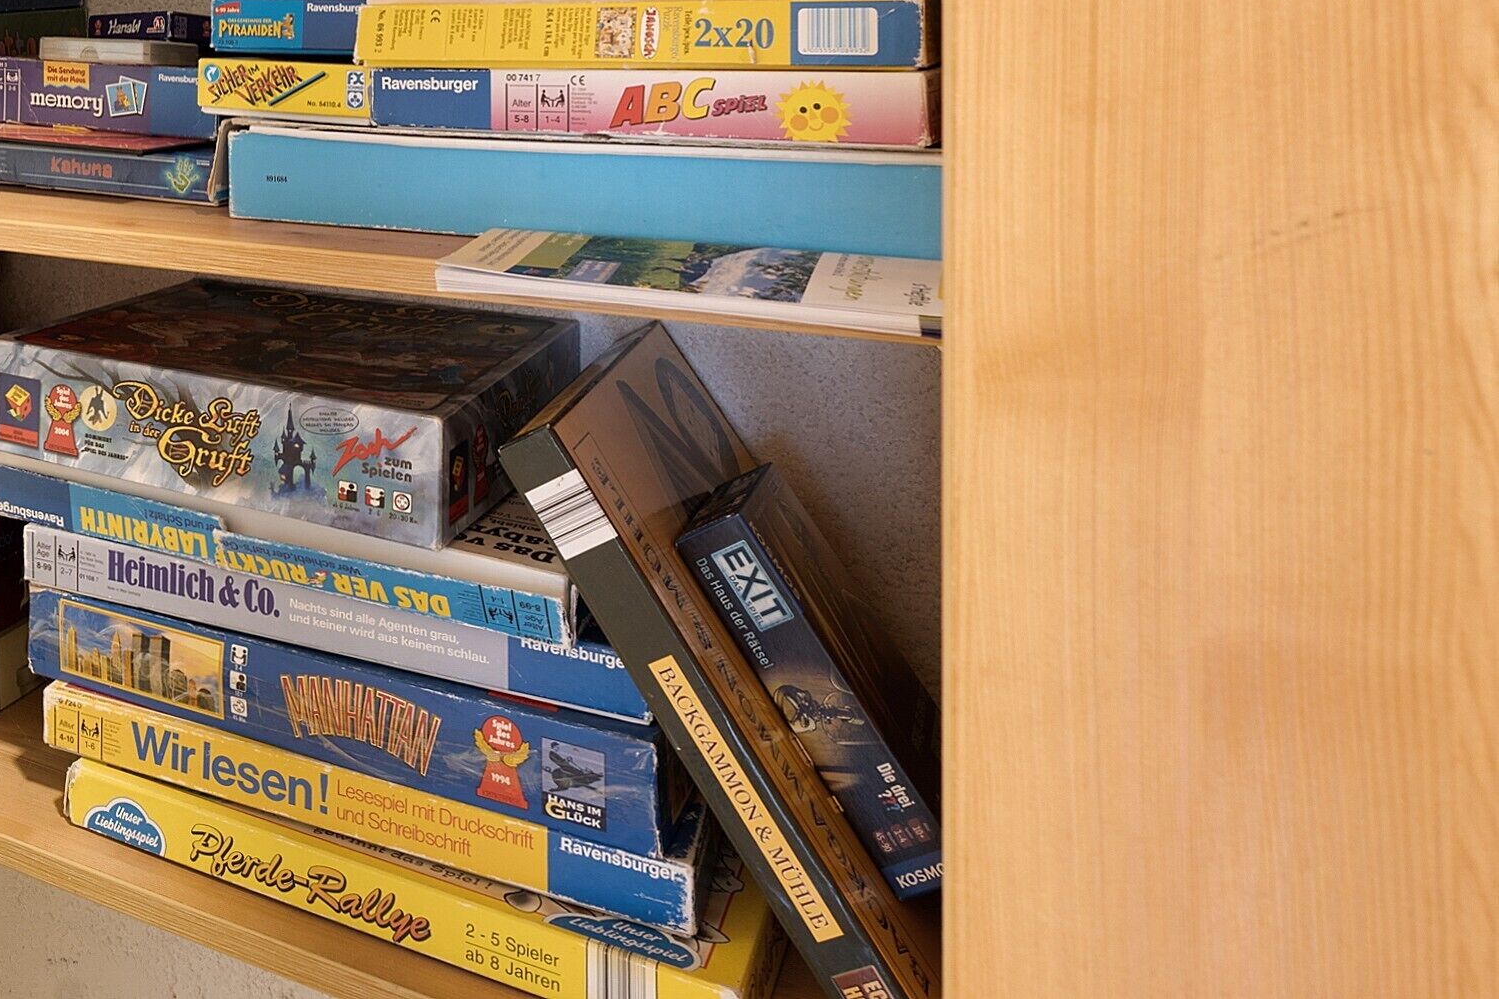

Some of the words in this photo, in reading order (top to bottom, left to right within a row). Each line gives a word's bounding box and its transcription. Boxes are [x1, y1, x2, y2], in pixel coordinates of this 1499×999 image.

[219, 18, 283, 39] PYRAMIDEN
[694, 17, 774, 50] 2x20
[30, 91, 103, 117] memory
[234, 65, 303, 106] VERKEHR
[381, 76, 479, 92] Ravensburger
[512, 98, 531, 108] Alter
[610, 78, 718, 129] ABC
[712, 95, 769, 117] SPIEL
[514, 114, 530, 123] 5-8
[545, 115, 561, 124] 1-4
[156, 425, 253, 486] Gruft
[361, 462, 413, 484] Spielen
[384, 458, 413, 470] zum
[36, 562, 52, 572] 8-99
[106, 549, 214, 604] Heimlich
[218, 576, 241, 608] &
[244, 579, 281, 618] Co.
[289, 597, 326, 617] Nachts
[329, 607, 353, 622] sind
[356, 612, 375, 626] alle
[377, 618, 427, 637] Agenten
[430, 630, 459, 645] grau,
[289, 612, 310, 627] und
[312, 616, 347, 634] keiner
[349, 624, 375, 640] wird
[377, 632, 398, 645] aus
[401, 635, 444, 653] keinem
[447, 644, 490, 665] schlau.
[280, 673, 441, 776] MANHATTAN
[131, 721, 195, 774] Wir
[203, 742, 330, 814] lesen!
[876, 762, 897, 782] Die
[890, 782, 914, 809] drei
[115, 805, 143, 826] Unser
[336, 778, 408, 815] Lesespiel
[412, 800, 434, 820] mit
[439, 805, 535, 850] Druckschrift
[657, 666, 763, 821] BACKGAMMON
[755, 827, 770, 843] &
[767, 847, 829, 930] MÜHLE
[95, 812, 159, 848] Lieblingsspiel
[336, 807, 364, 828] und
[368, 814, 472, 857] Schreibschrift
[559, 837, 677, 882] Ravensburger
[190, 823, 432, 944] Pferde-Rallye
[464, 949, 484, 967] ab
[488, 955, 500, 971] 8
[503, 959, 561, 992] Jahren
